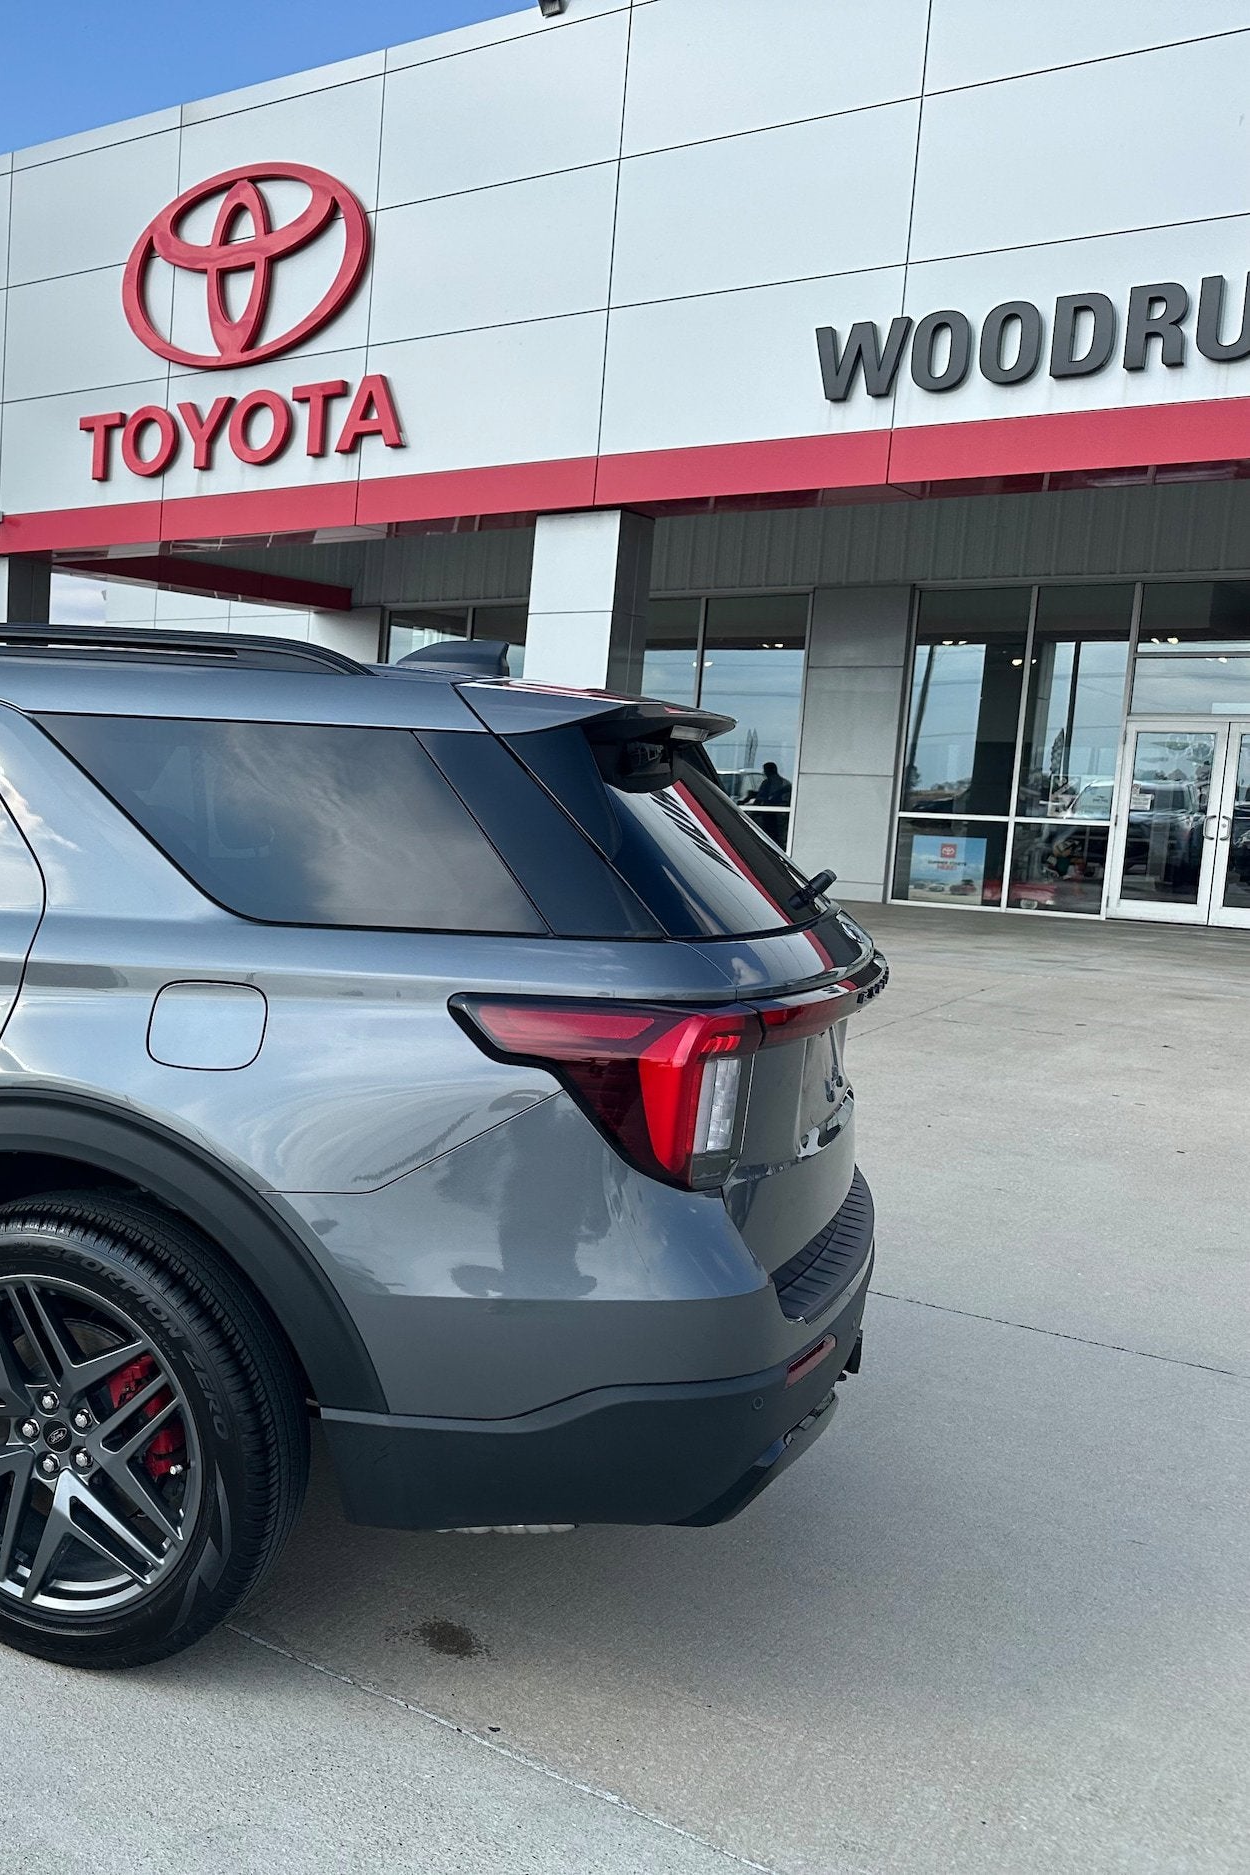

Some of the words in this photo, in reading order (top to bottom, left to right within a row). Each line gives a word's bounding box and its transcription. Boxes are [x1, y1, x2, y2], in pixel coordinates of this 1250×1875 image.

[815, 271, 1250, 402] WOODRU
[79, 374, 406, 480] TOYOTA
[42, 1244, 186, 1342] SCORPION
[182, 1348, 229, 1440] ZERO
